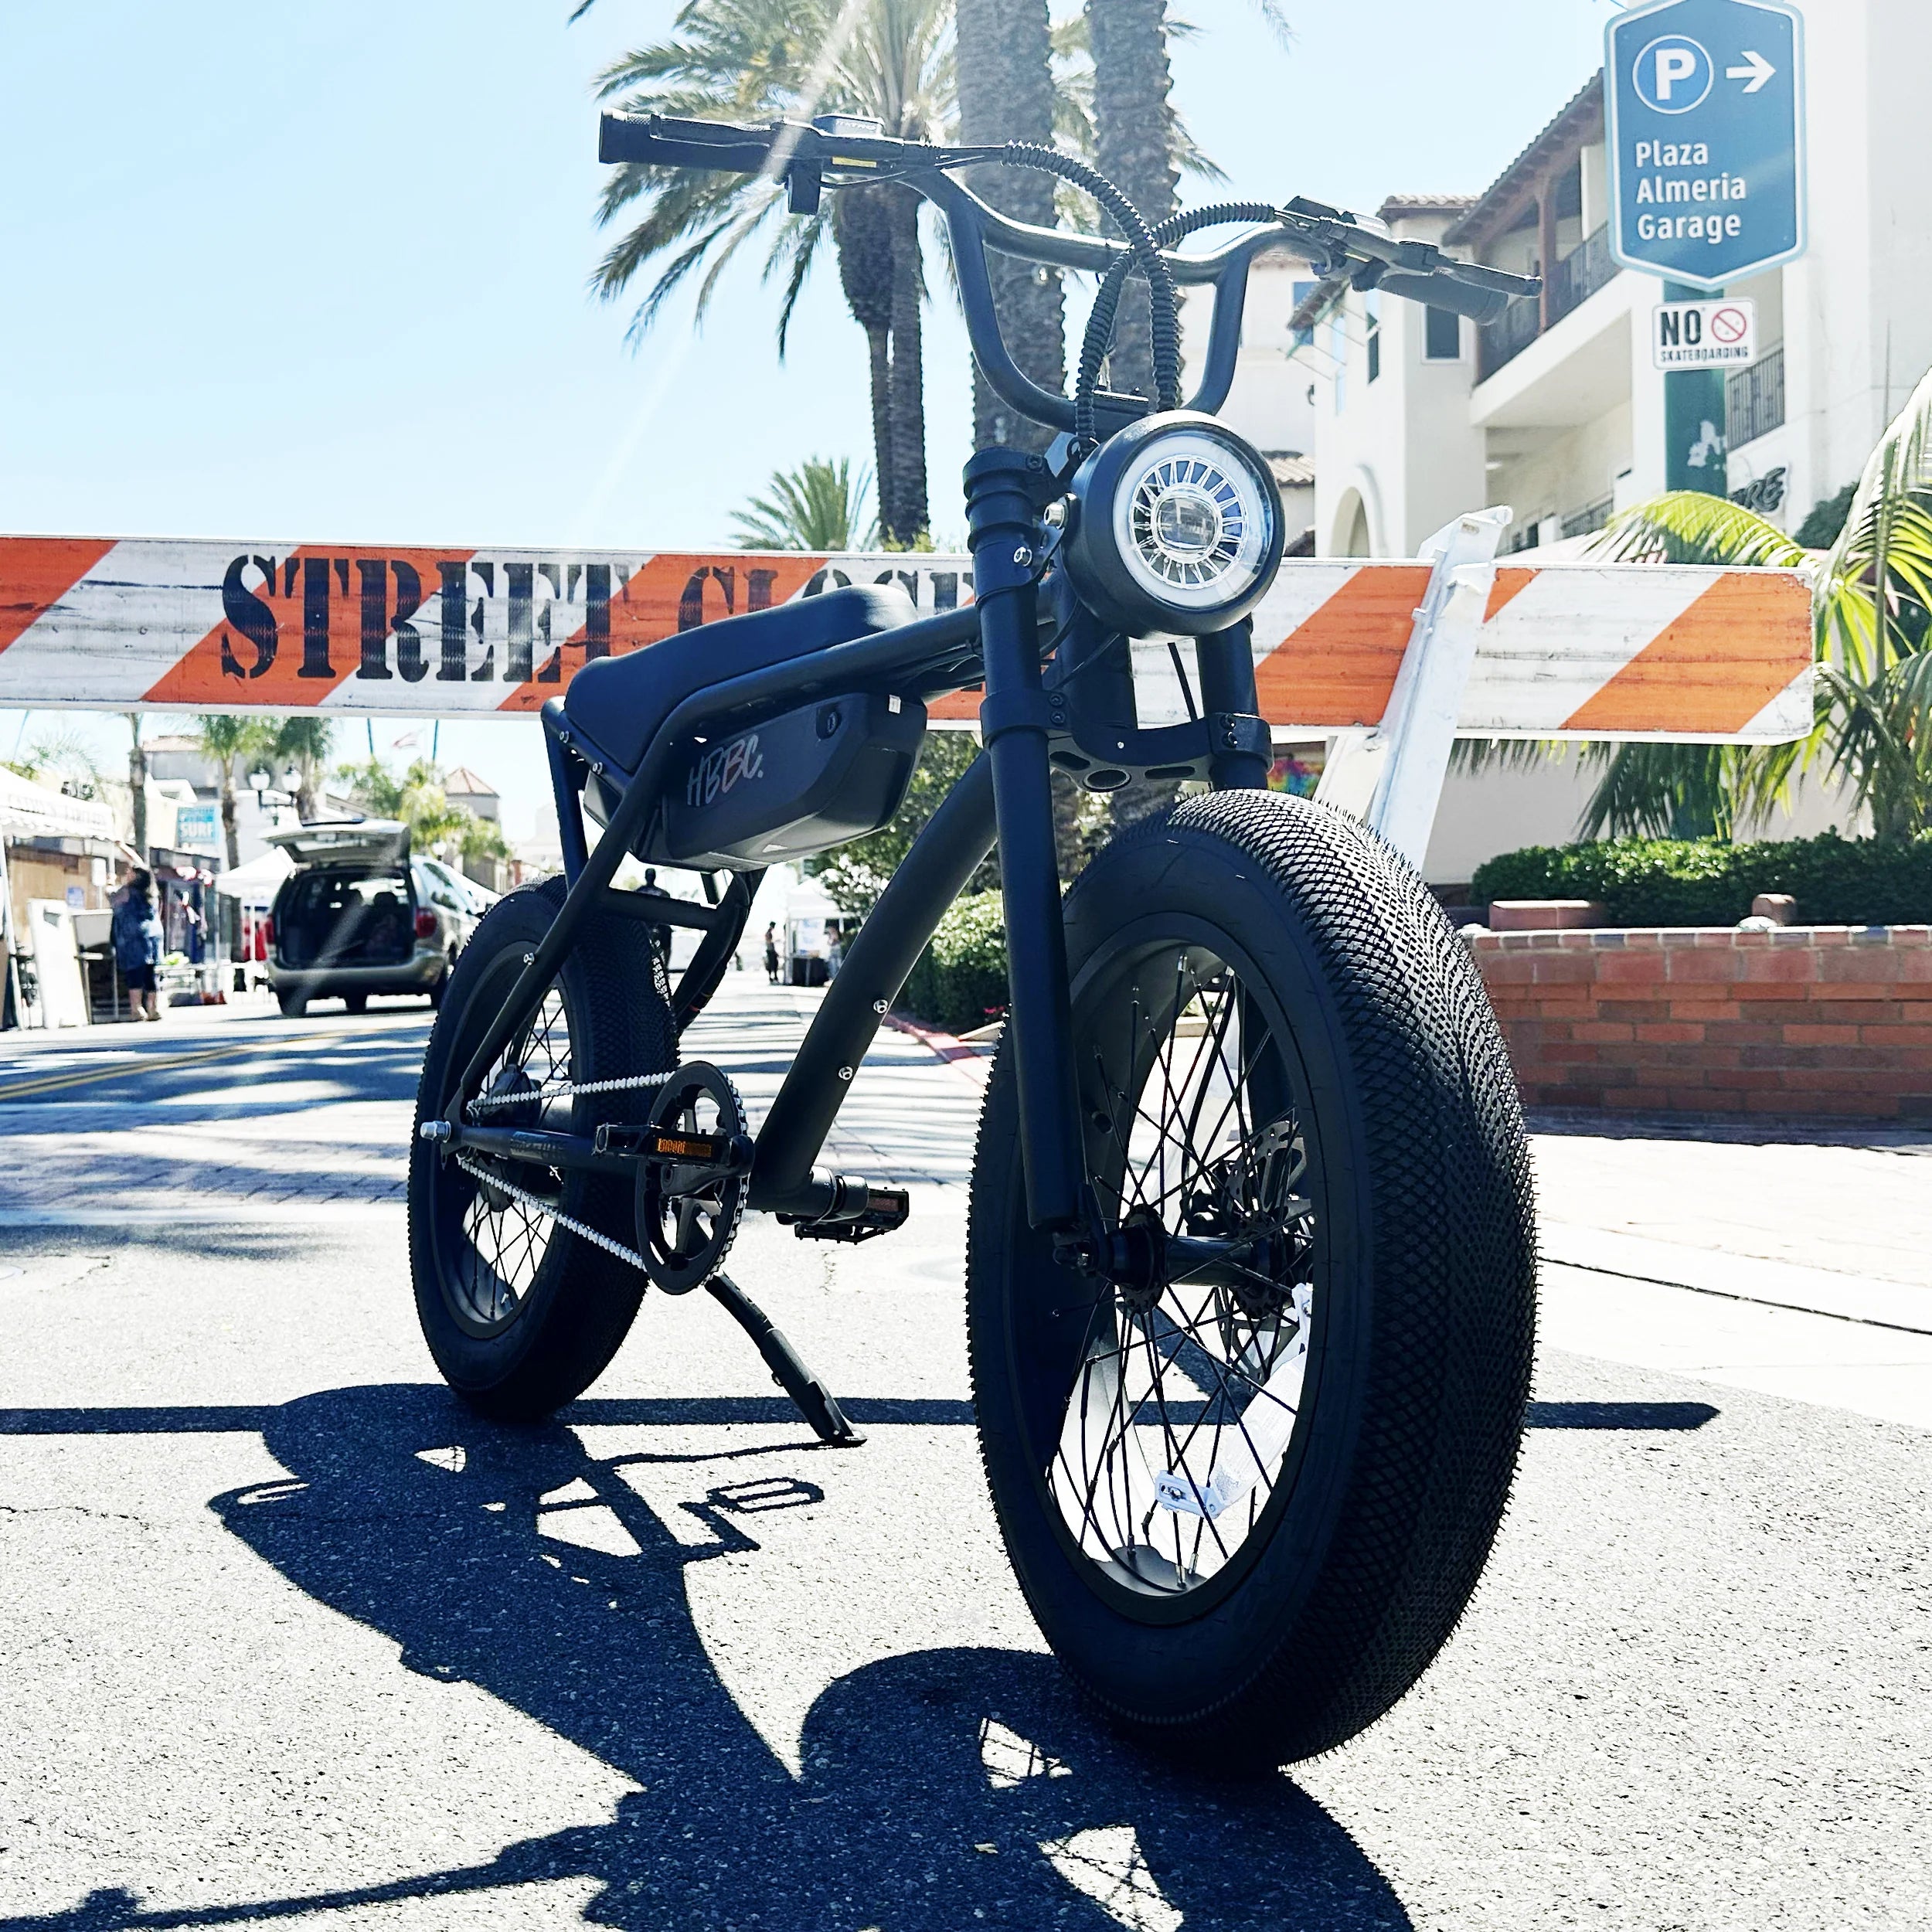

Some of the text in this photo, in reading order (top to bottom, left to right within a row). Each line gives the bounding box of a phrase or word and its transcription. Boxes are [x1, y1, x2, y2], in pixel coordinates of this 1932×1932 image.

[1655, 49, 1696, 100] P
[1635, 139, 1708, 168] Plaza
[1636, 172, 1747, 204] Almeria
[1637, 213, 1741, 244] Garage
[1660, 310, 1701, 346] NO
[1661, 346, 1748, 362] SKATEBOARDING
[221, 554, 630, 683] STREET
[180, 821, 213, 838] SURF
